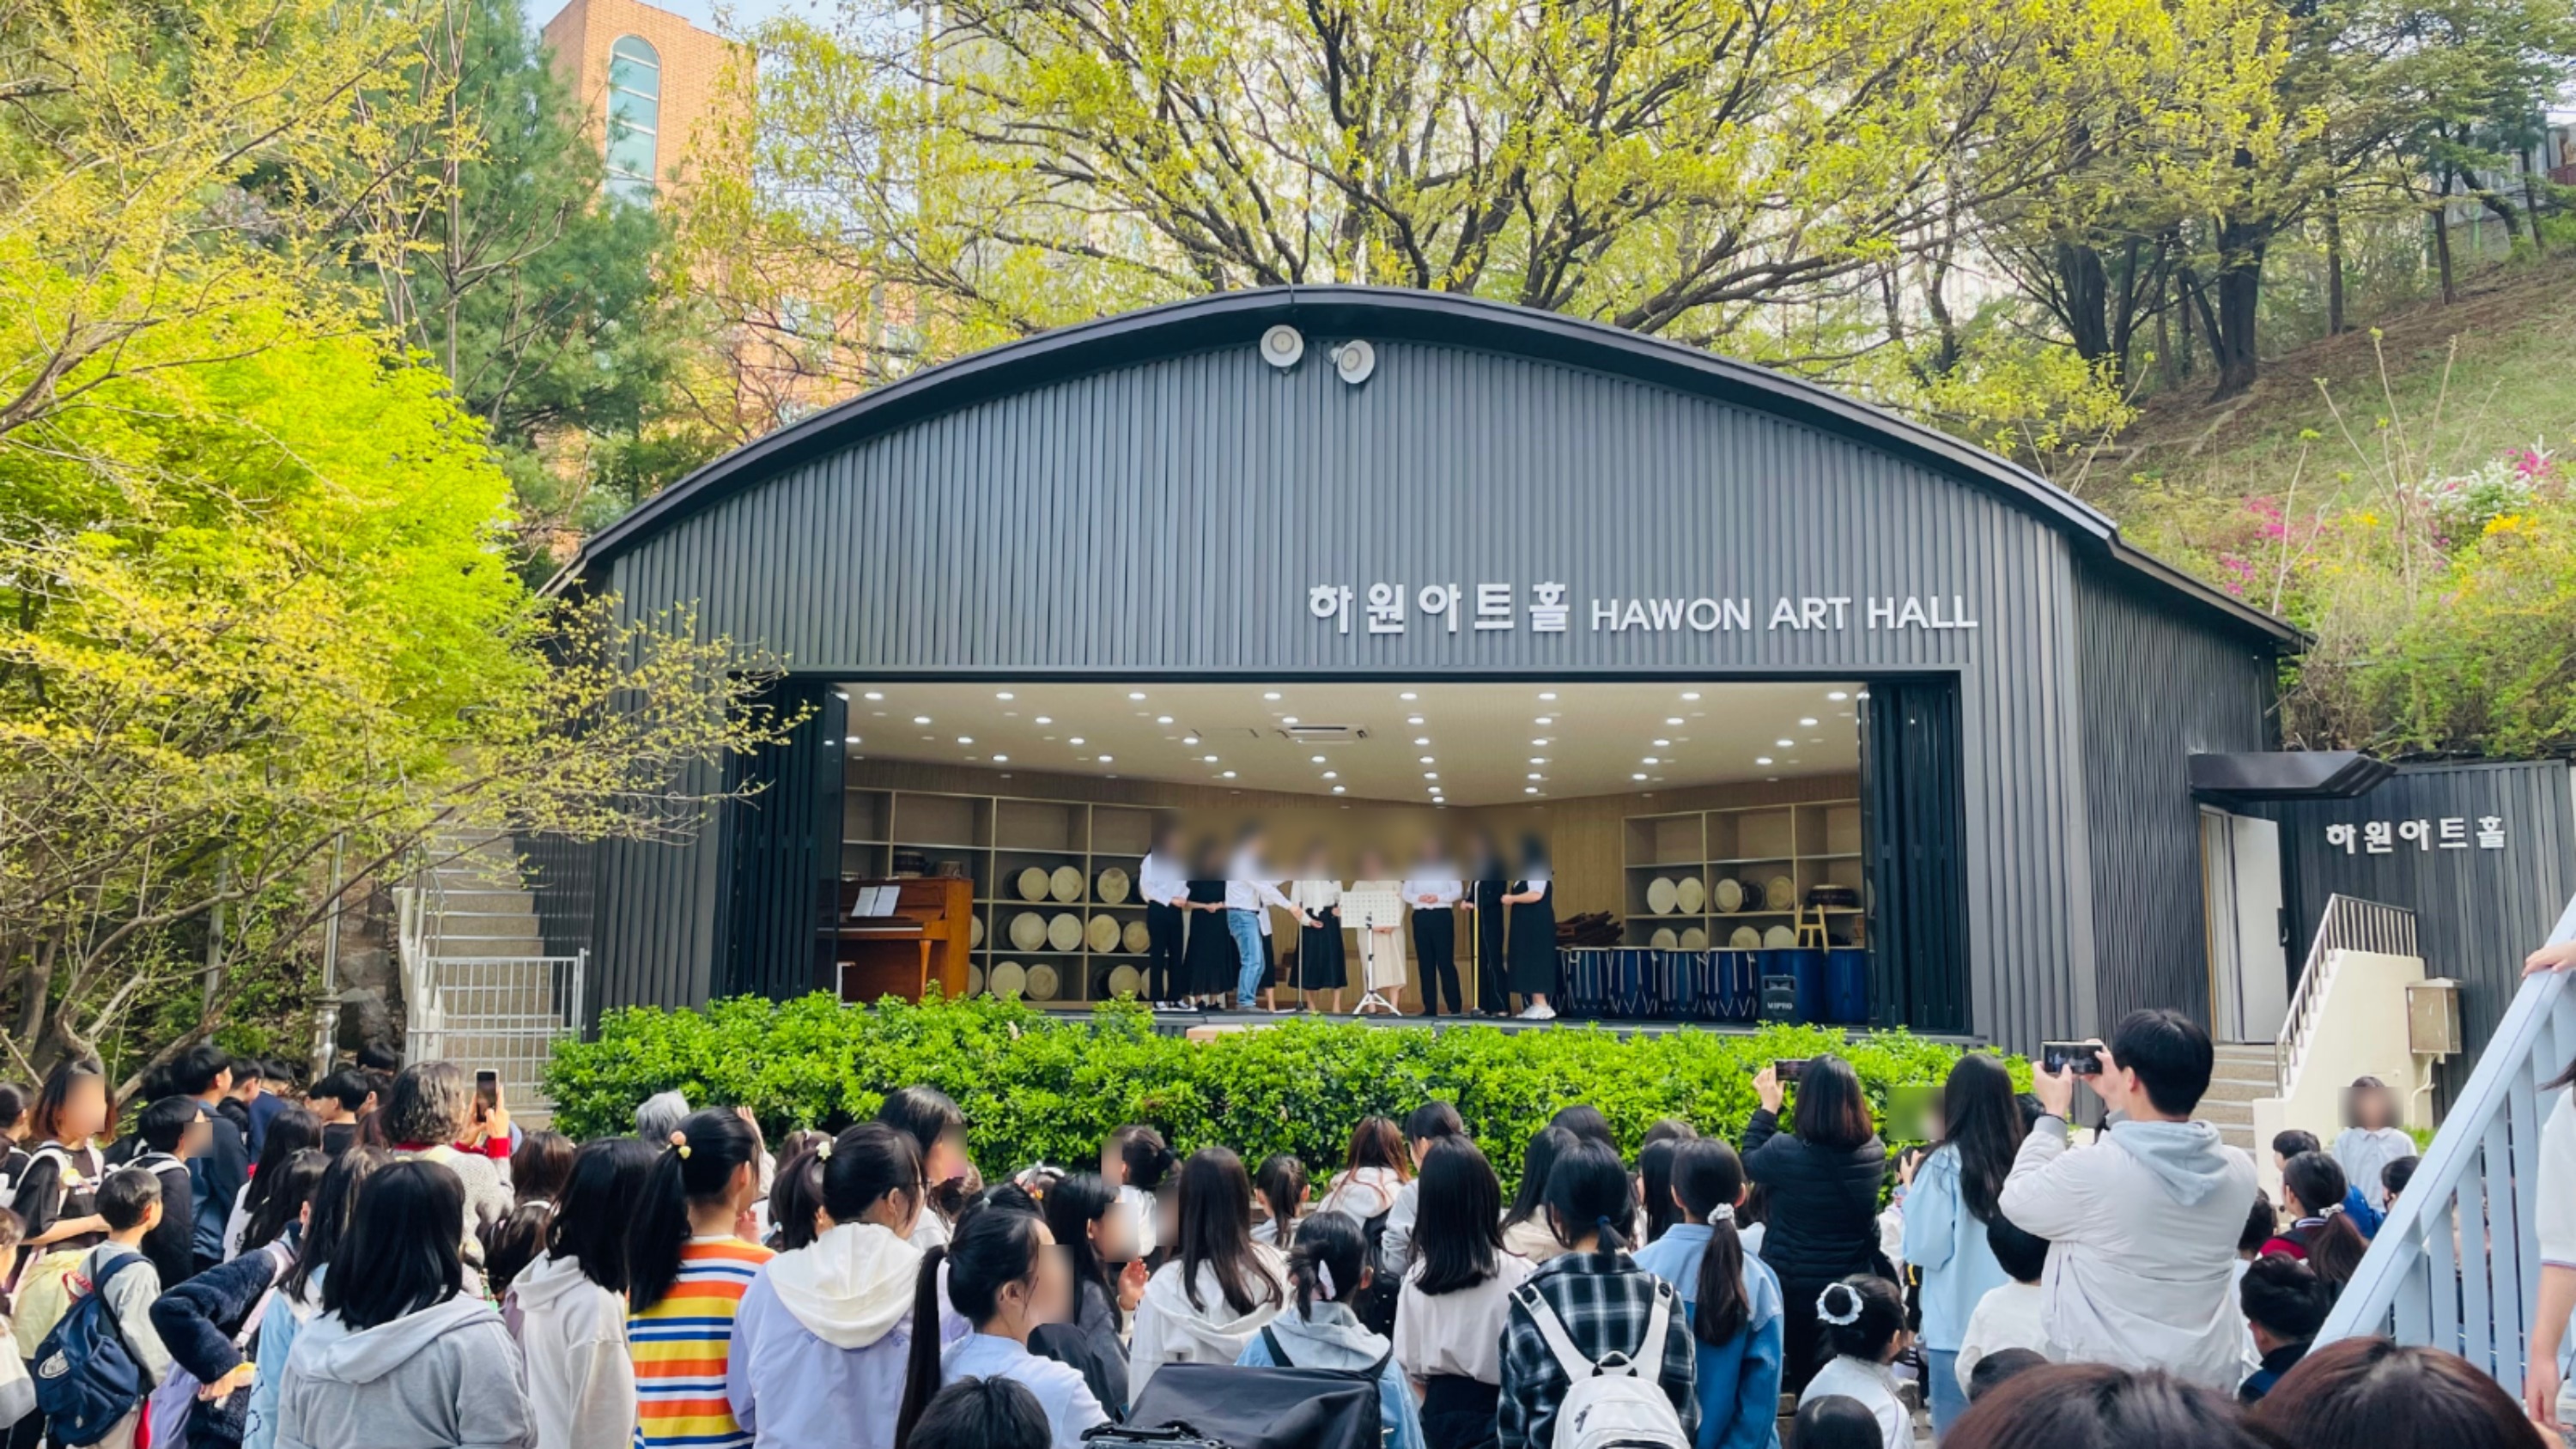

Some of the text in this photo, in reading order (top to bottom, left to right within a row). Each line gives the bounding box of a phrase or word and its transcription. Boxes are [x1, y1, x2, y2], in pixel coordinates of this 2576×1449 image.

[1309, 581, 1570, 634] 하원아트홀
[1592, 595, 1978, 631] HAWON ART HALL
[2325, 815, 2506, 854] 하원아트홀
